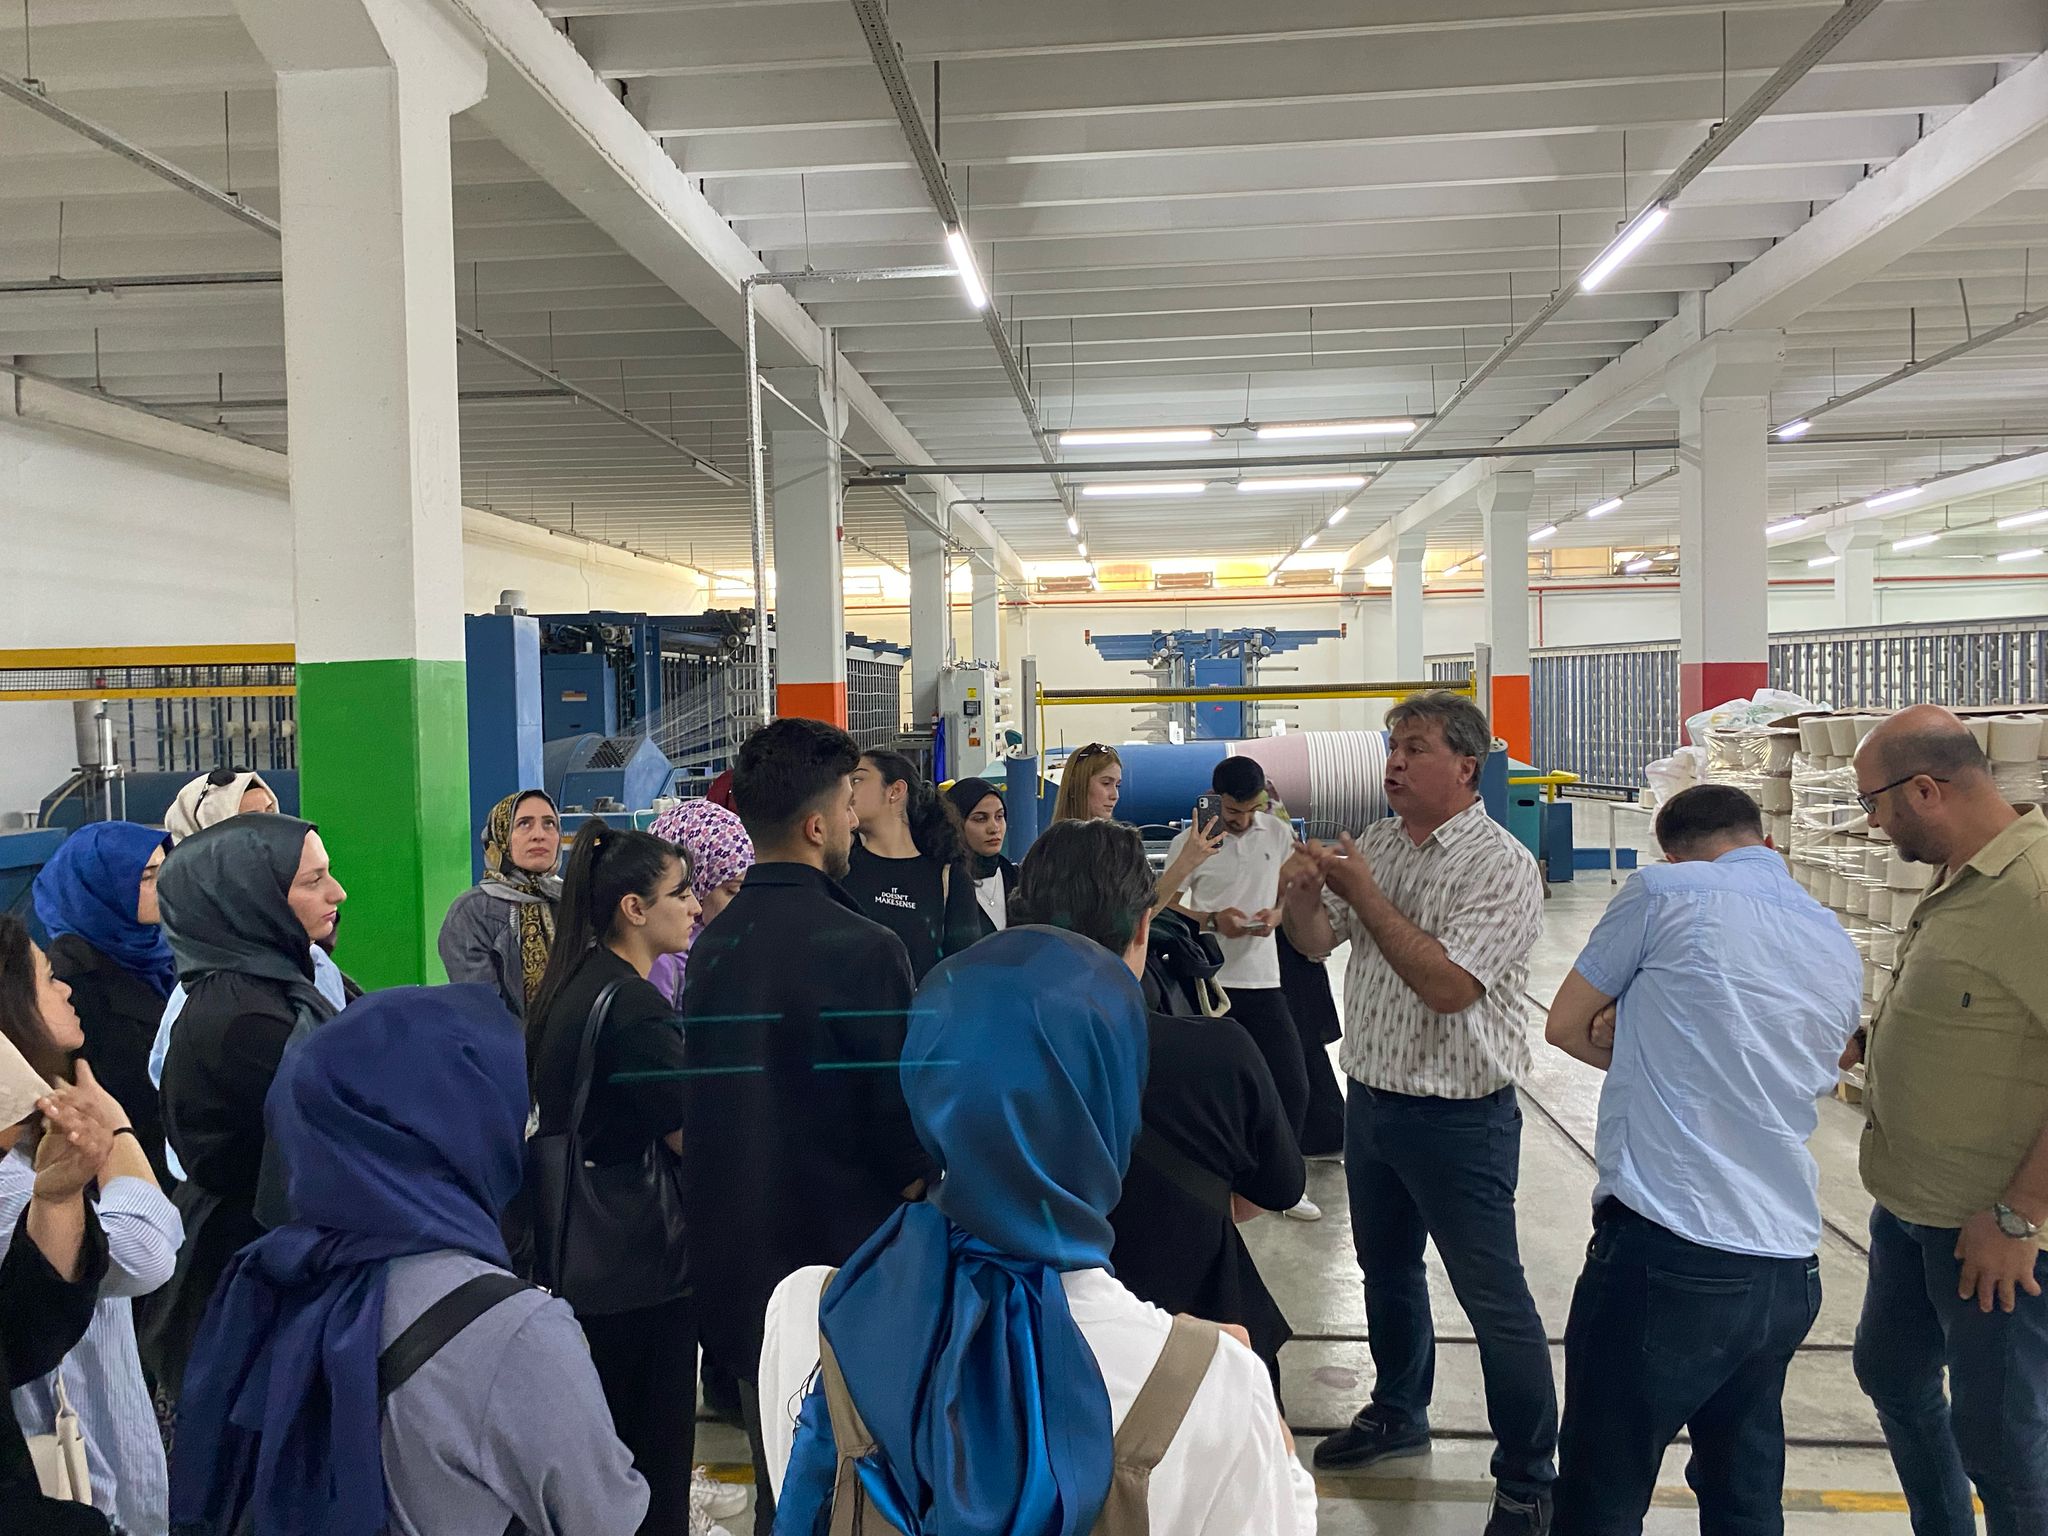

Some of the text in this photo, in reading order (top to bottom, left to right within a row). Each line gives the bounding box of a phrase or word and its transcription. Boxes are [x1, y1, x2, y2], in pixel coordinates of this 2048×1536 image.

[881, 891, 908, 900] DOESN'T
[874, 896, 916, 909] MAKE SENSE
